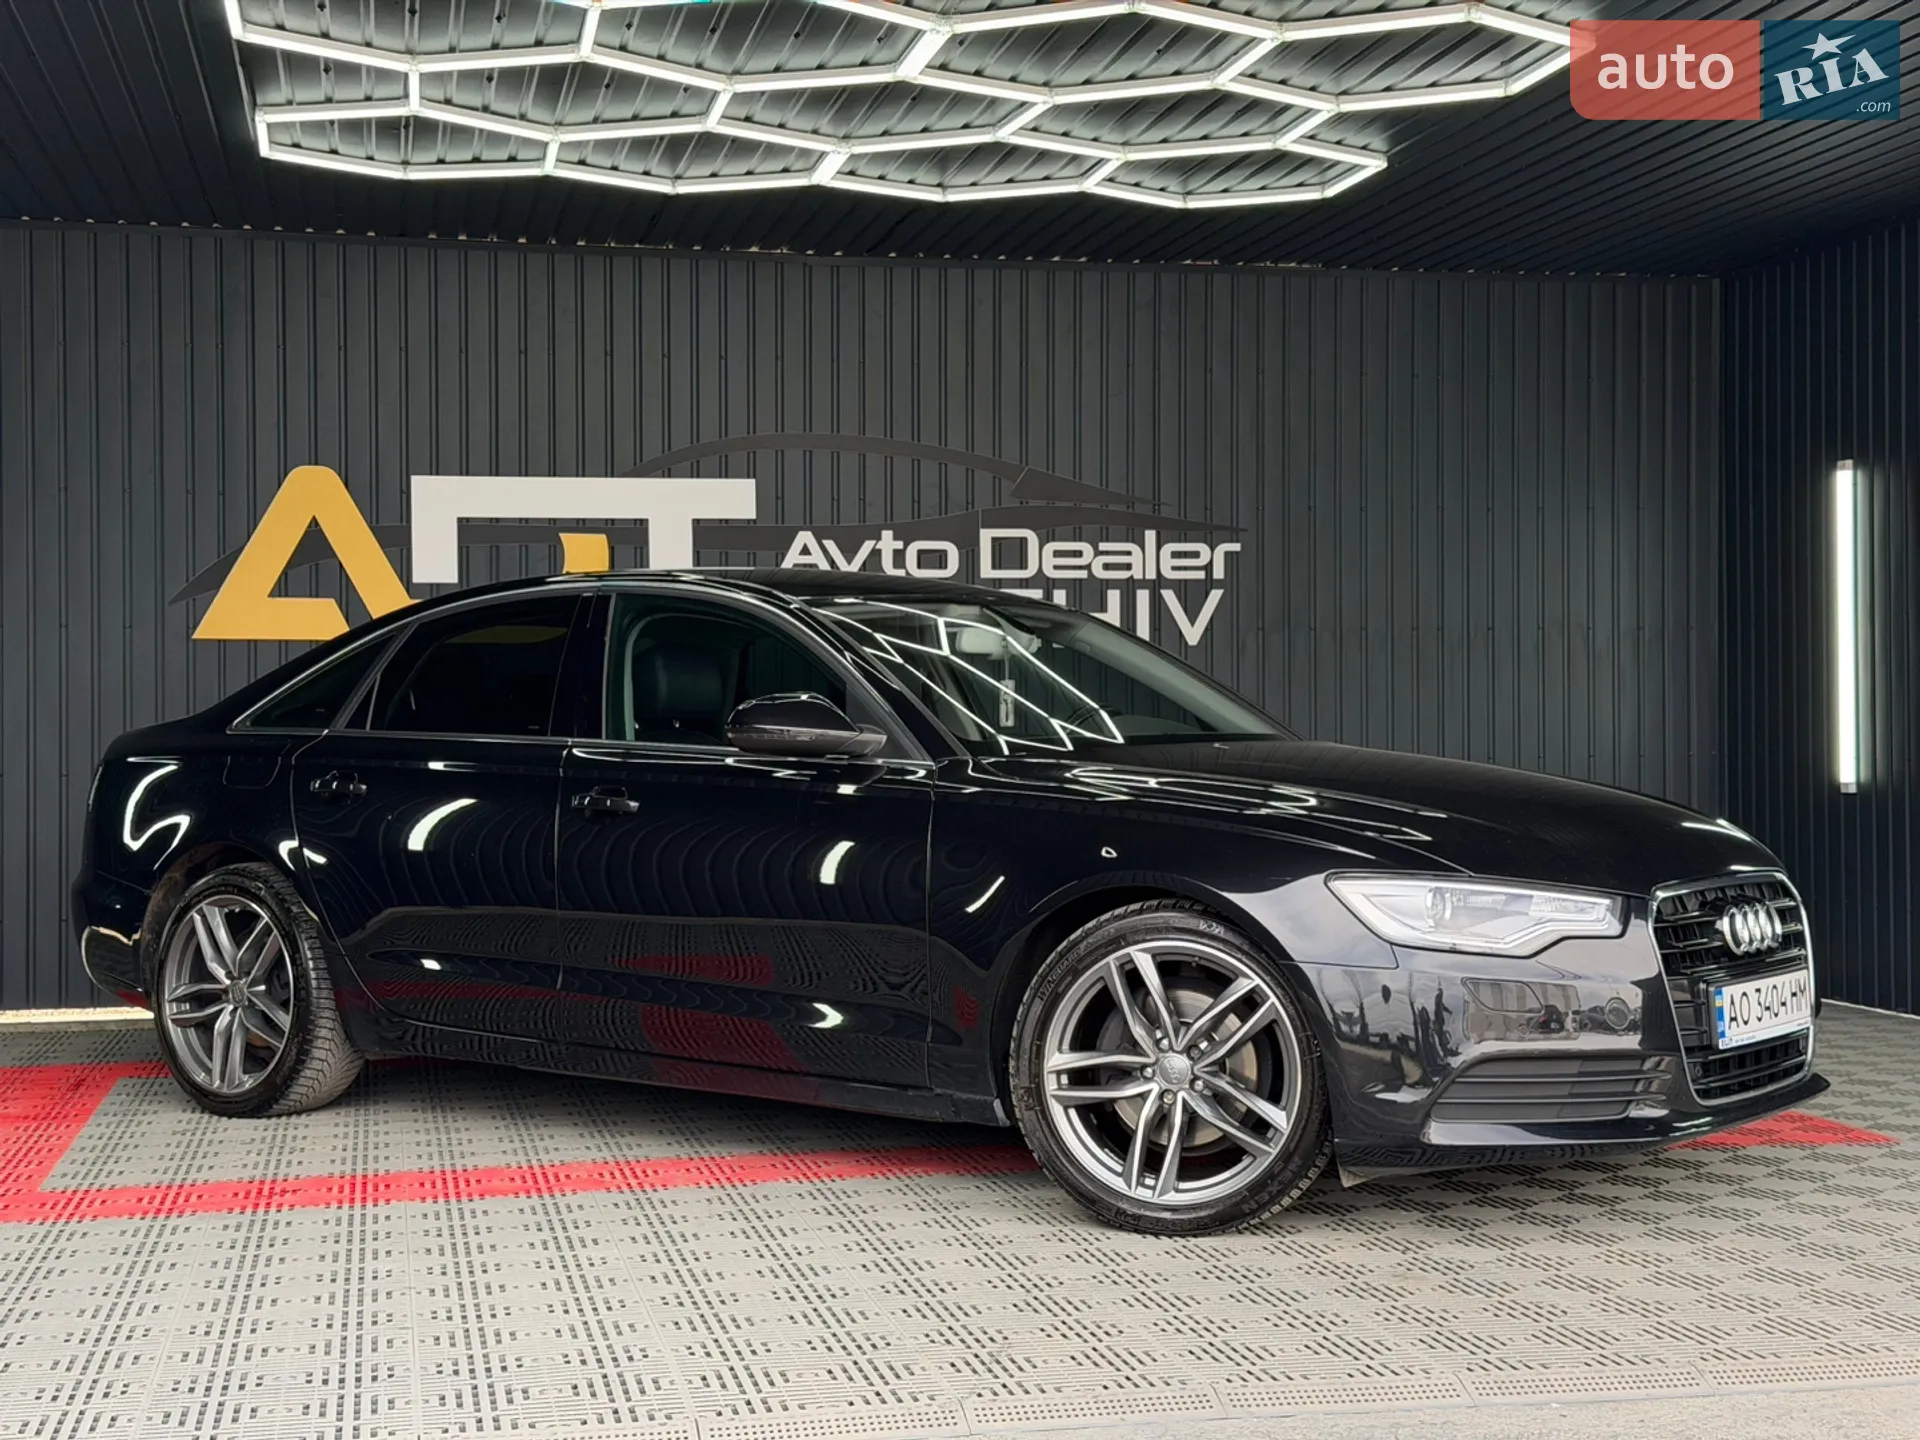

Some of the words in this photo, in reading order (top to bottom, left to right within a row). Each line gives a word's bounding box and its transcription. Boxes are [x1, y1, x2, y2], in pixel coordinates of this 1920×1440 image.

[780, 529, 960, 579] Avto
[980, 528, 1241, 580] Dealer
[1728, 990, 1751, 1030] AO
[1754, 980, 1789, 1023] 3404
